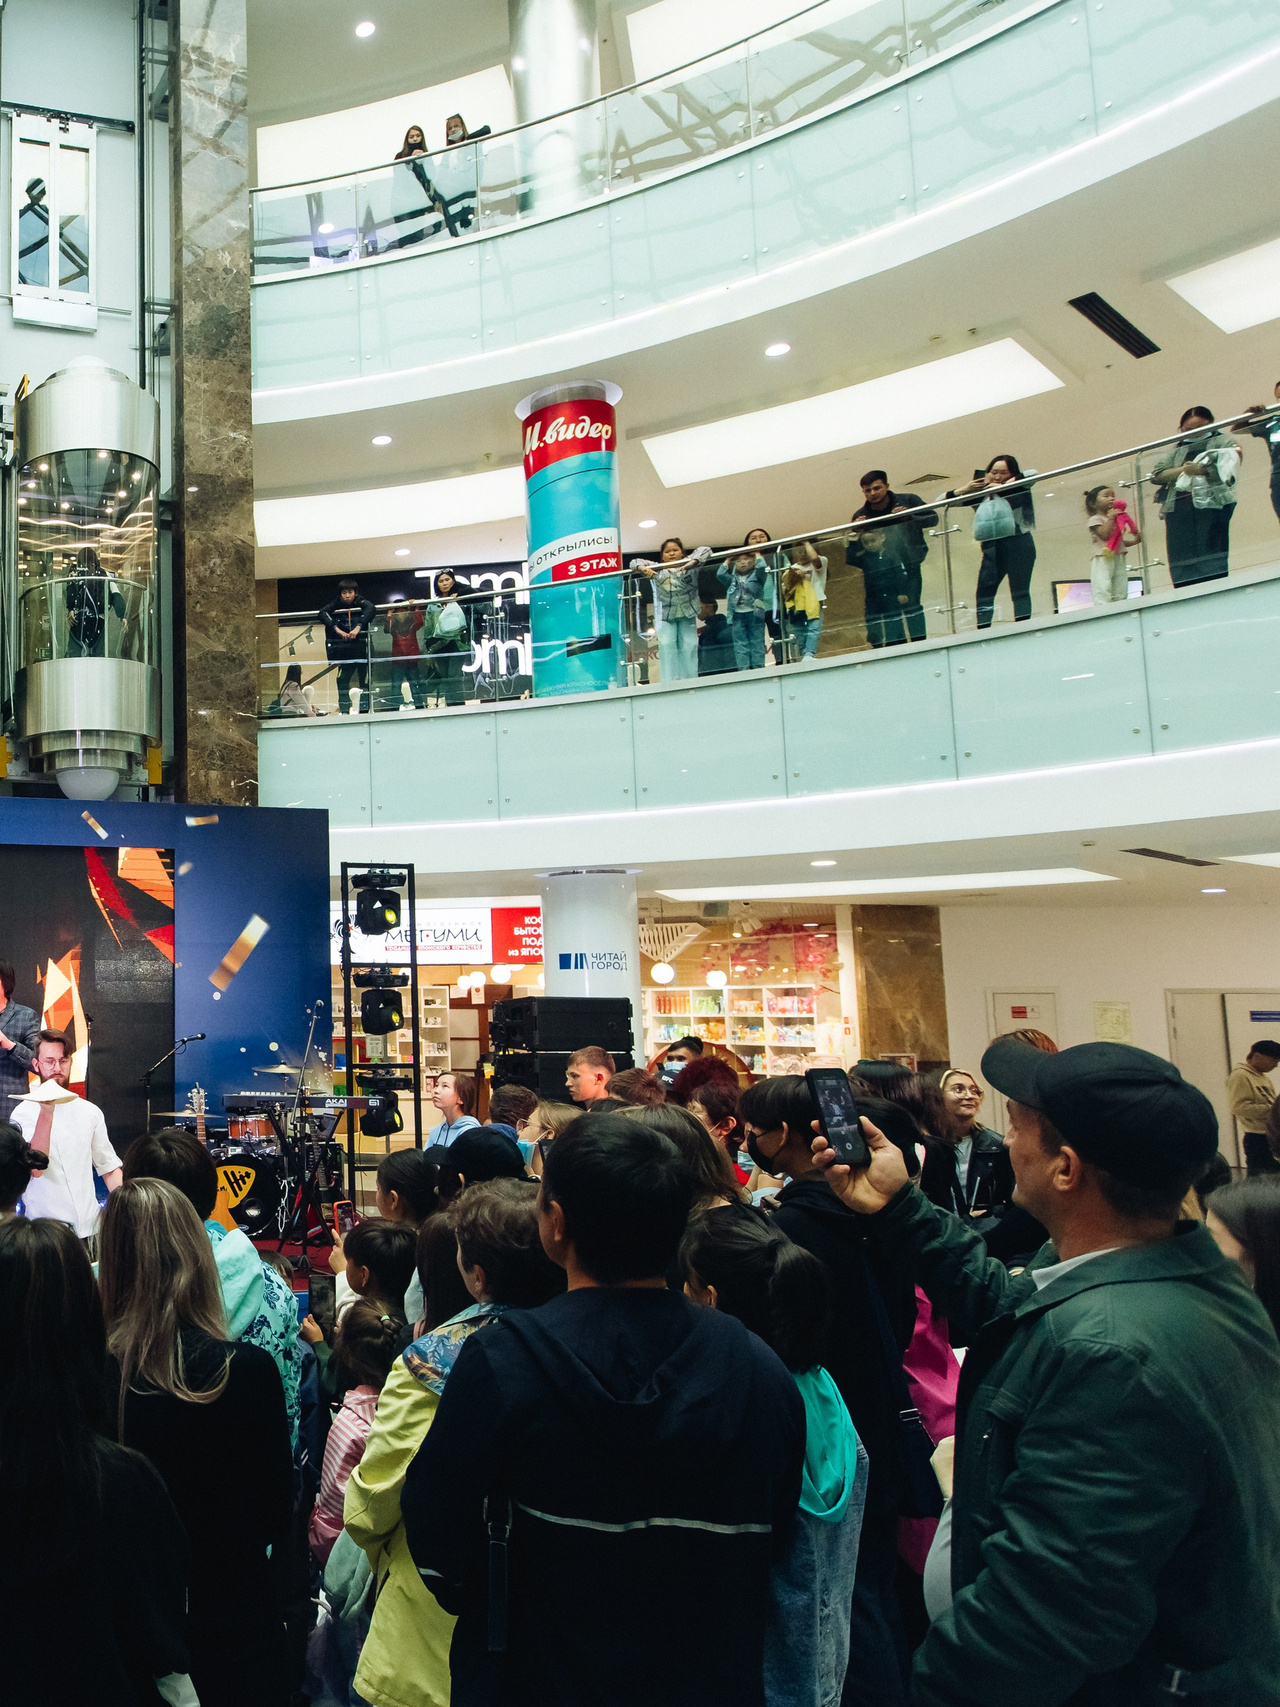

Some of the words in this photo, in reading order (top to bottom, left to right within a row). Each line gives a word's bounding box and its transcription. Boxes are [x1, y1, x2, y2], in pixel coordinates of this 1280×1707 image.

[536, 536, 613, 566] ОТКРЫЛИСЬ!
[567, 564, 577, 576] 3
[579, 557, 618, 572] ЭТАЖ
[590, 951, 627, 961] ЧИТАЙ
[590, 961, 628, 971] ГОРОД
